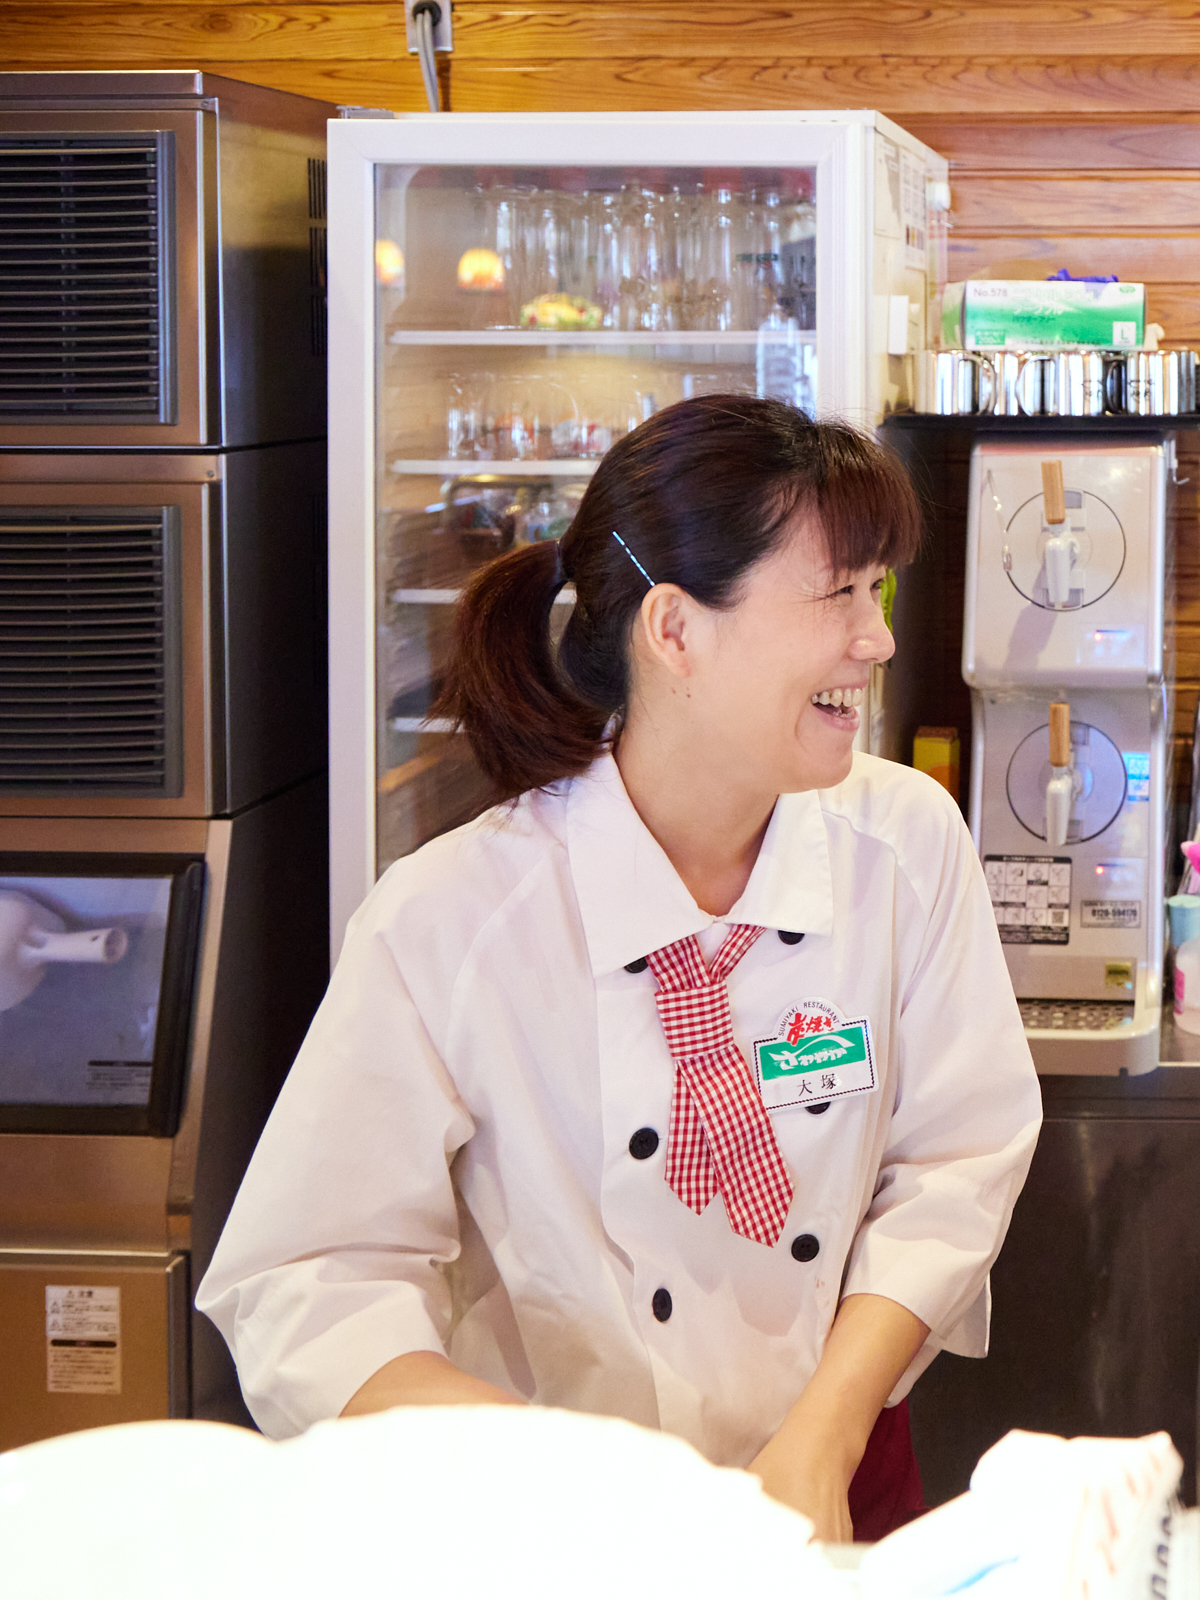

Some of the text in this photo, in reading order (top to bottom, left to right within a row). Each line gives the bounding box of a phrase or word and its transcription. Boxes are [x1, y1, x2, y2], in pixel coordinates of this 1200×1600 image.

[974, 287, 1007, 297] No.578
[1121, 329, 1129, 340] L
[778, 1001, 840, 1036] SUMIYAKI RESTAURANT
[787, 1012, 834, 1046] 炭焼き
[768, 1035, 855, 1070] さわやか
[797, 1073, 836, 1097] 大塚
